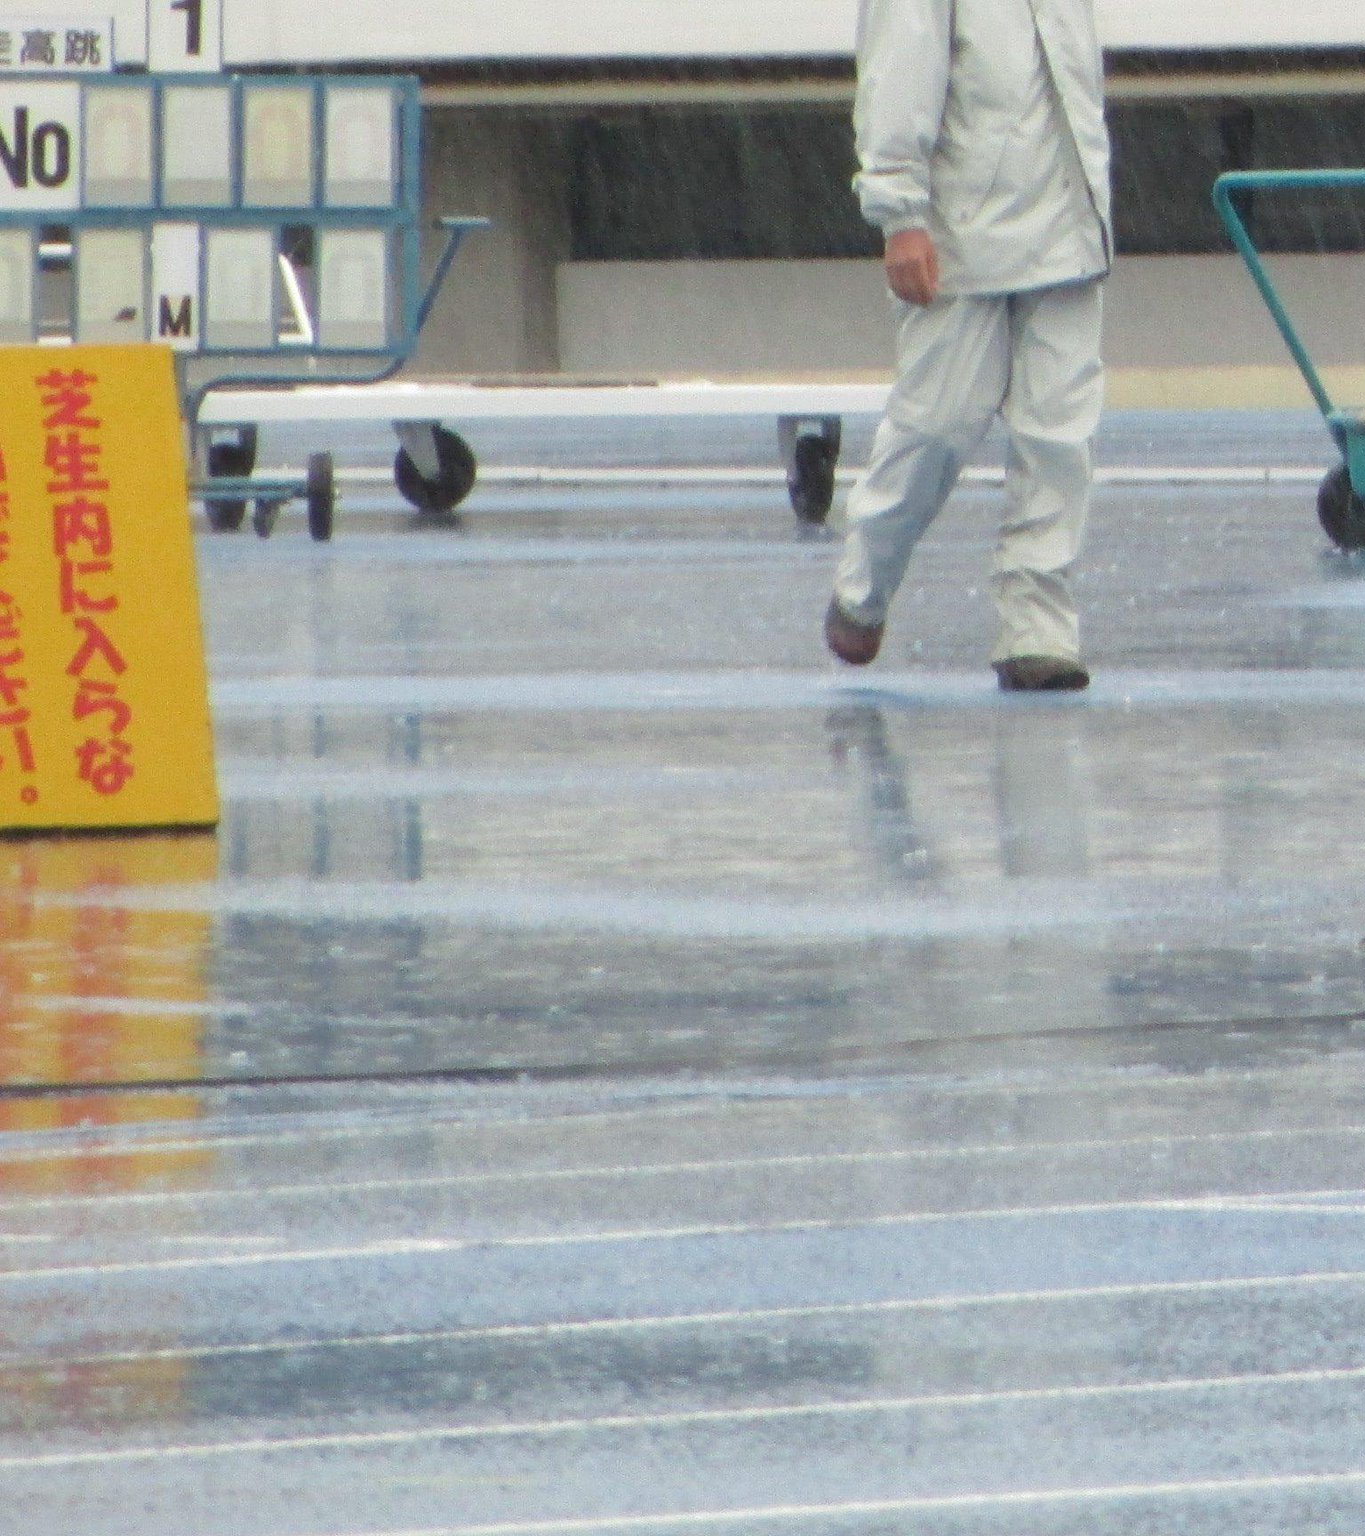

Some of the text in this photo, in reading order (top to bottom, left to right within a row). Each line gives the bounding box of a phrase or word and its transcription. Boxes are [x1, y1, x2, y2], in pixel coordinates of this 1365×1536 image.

[158, 295, 191, 337] M
[35, 369, 134, 794] 芝生内に入らな
